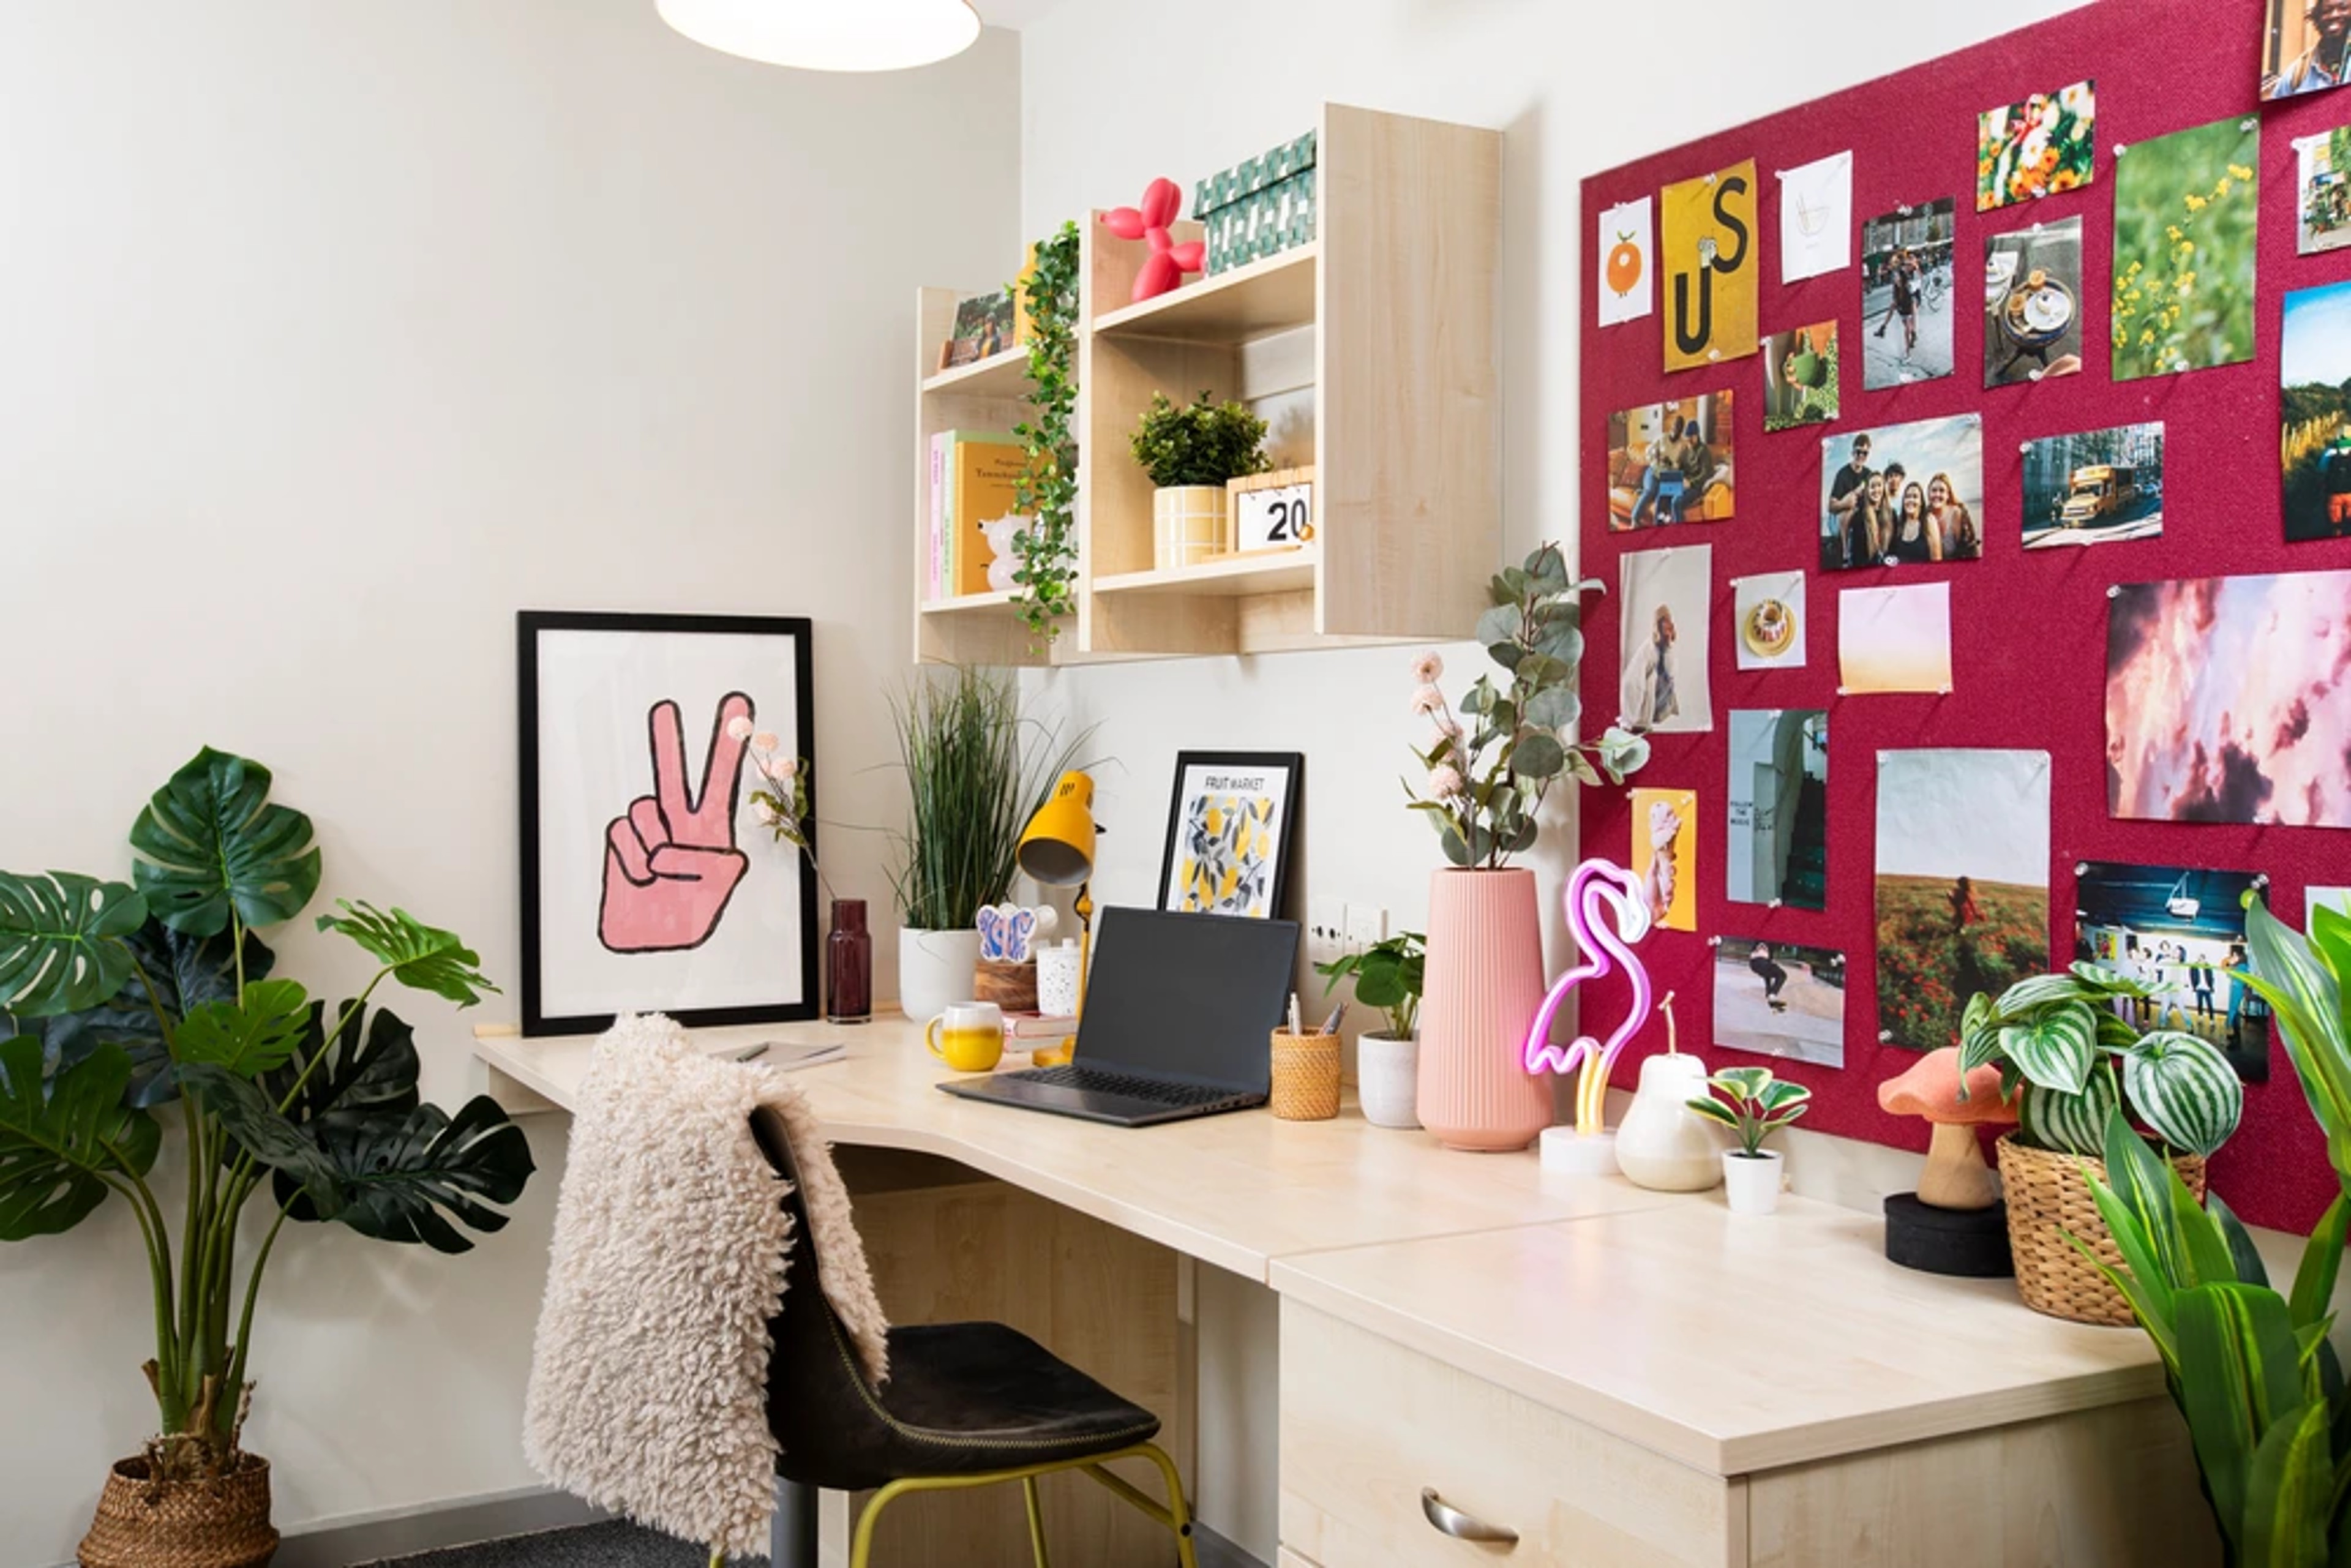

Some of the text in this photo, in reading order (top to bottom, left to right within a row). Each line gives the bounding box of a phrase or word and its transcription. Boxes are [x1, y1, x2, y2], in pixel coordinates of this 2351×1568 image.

[1267, 498, 1306, 541] 20
[1205, 776, 1265, 790] FRUIT MARKET
